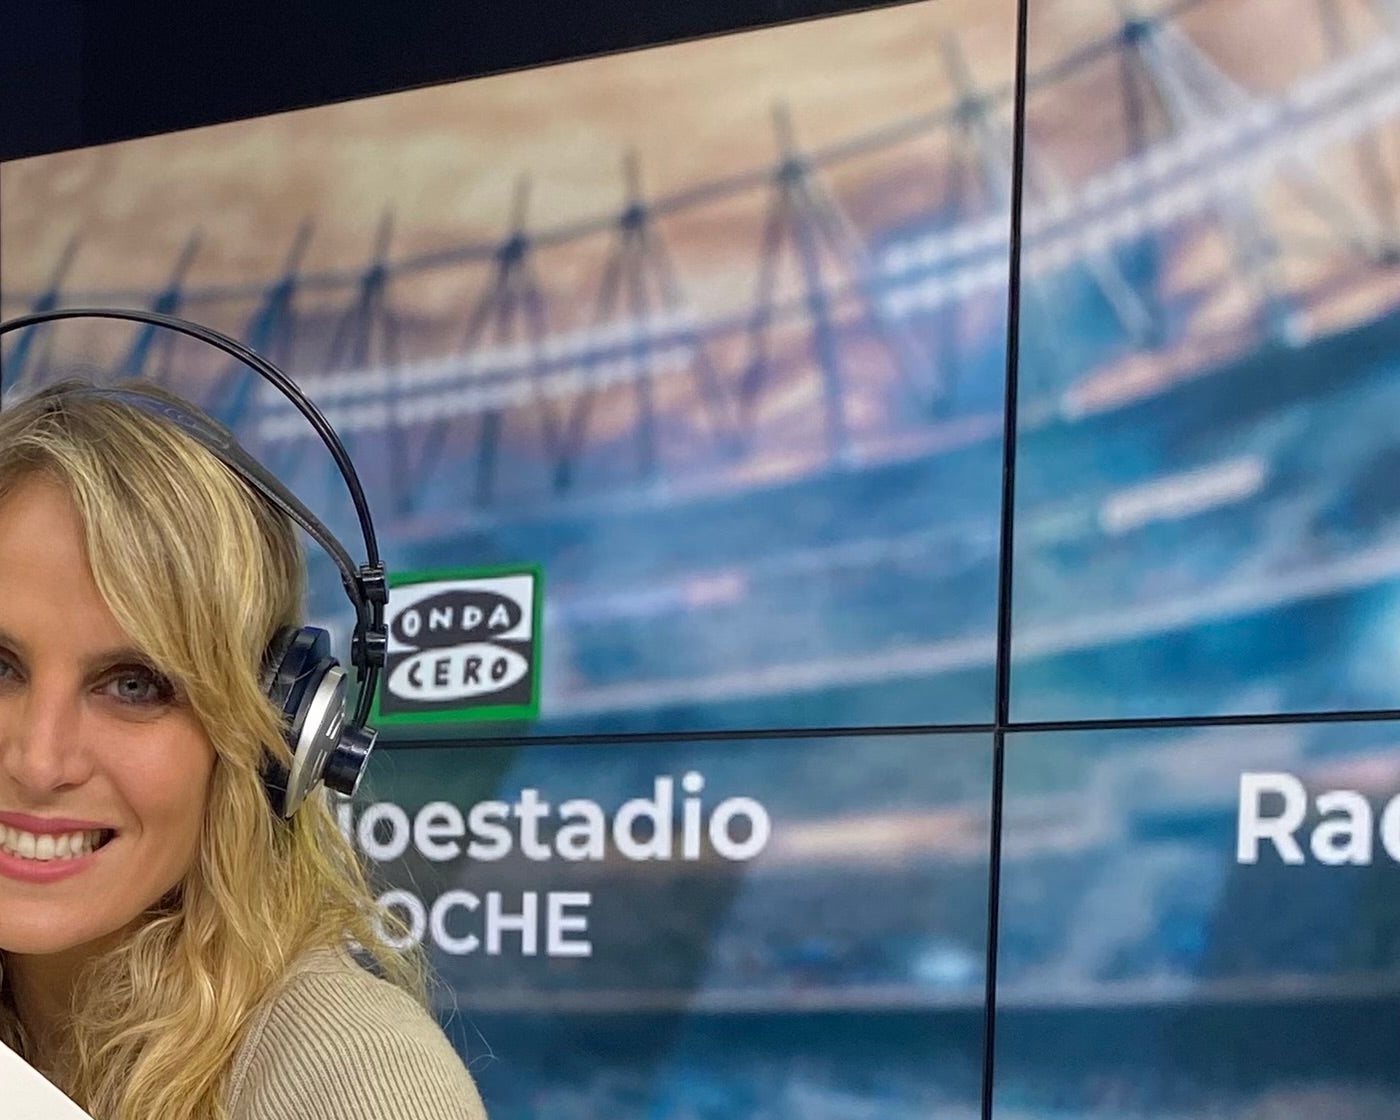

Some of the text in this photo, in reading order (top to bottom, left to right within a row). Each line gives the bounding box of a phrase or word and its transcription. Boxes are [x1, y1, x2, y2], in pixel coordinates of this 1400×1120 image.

[402, 604, 511, 637] ONDA
[407, 657, 508, 688] CERO
[373, 888, 592, 957] OCHE
